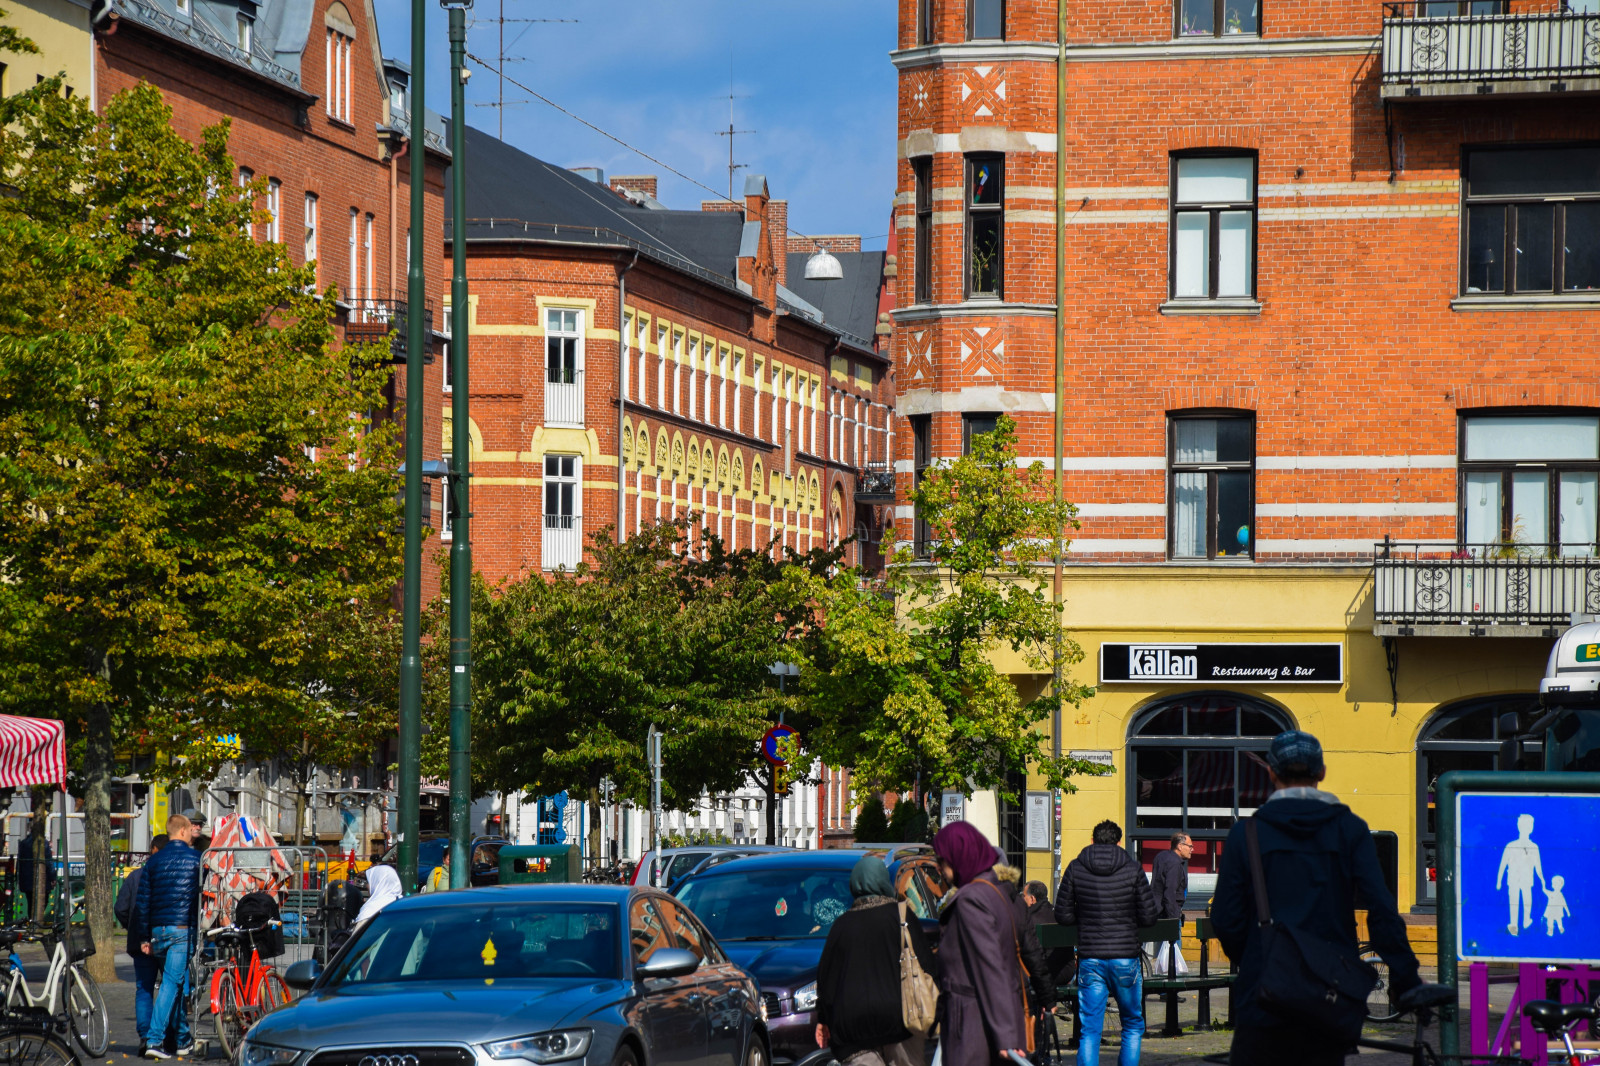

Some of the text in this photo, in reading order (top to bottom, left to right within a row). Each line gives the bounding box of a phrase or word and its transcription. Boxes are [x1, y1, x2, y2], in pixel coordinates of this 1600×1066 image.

[1129, 646, 1316, 679] Källan Restaurang & Bar
[1586, 644, 1600, 659] E
